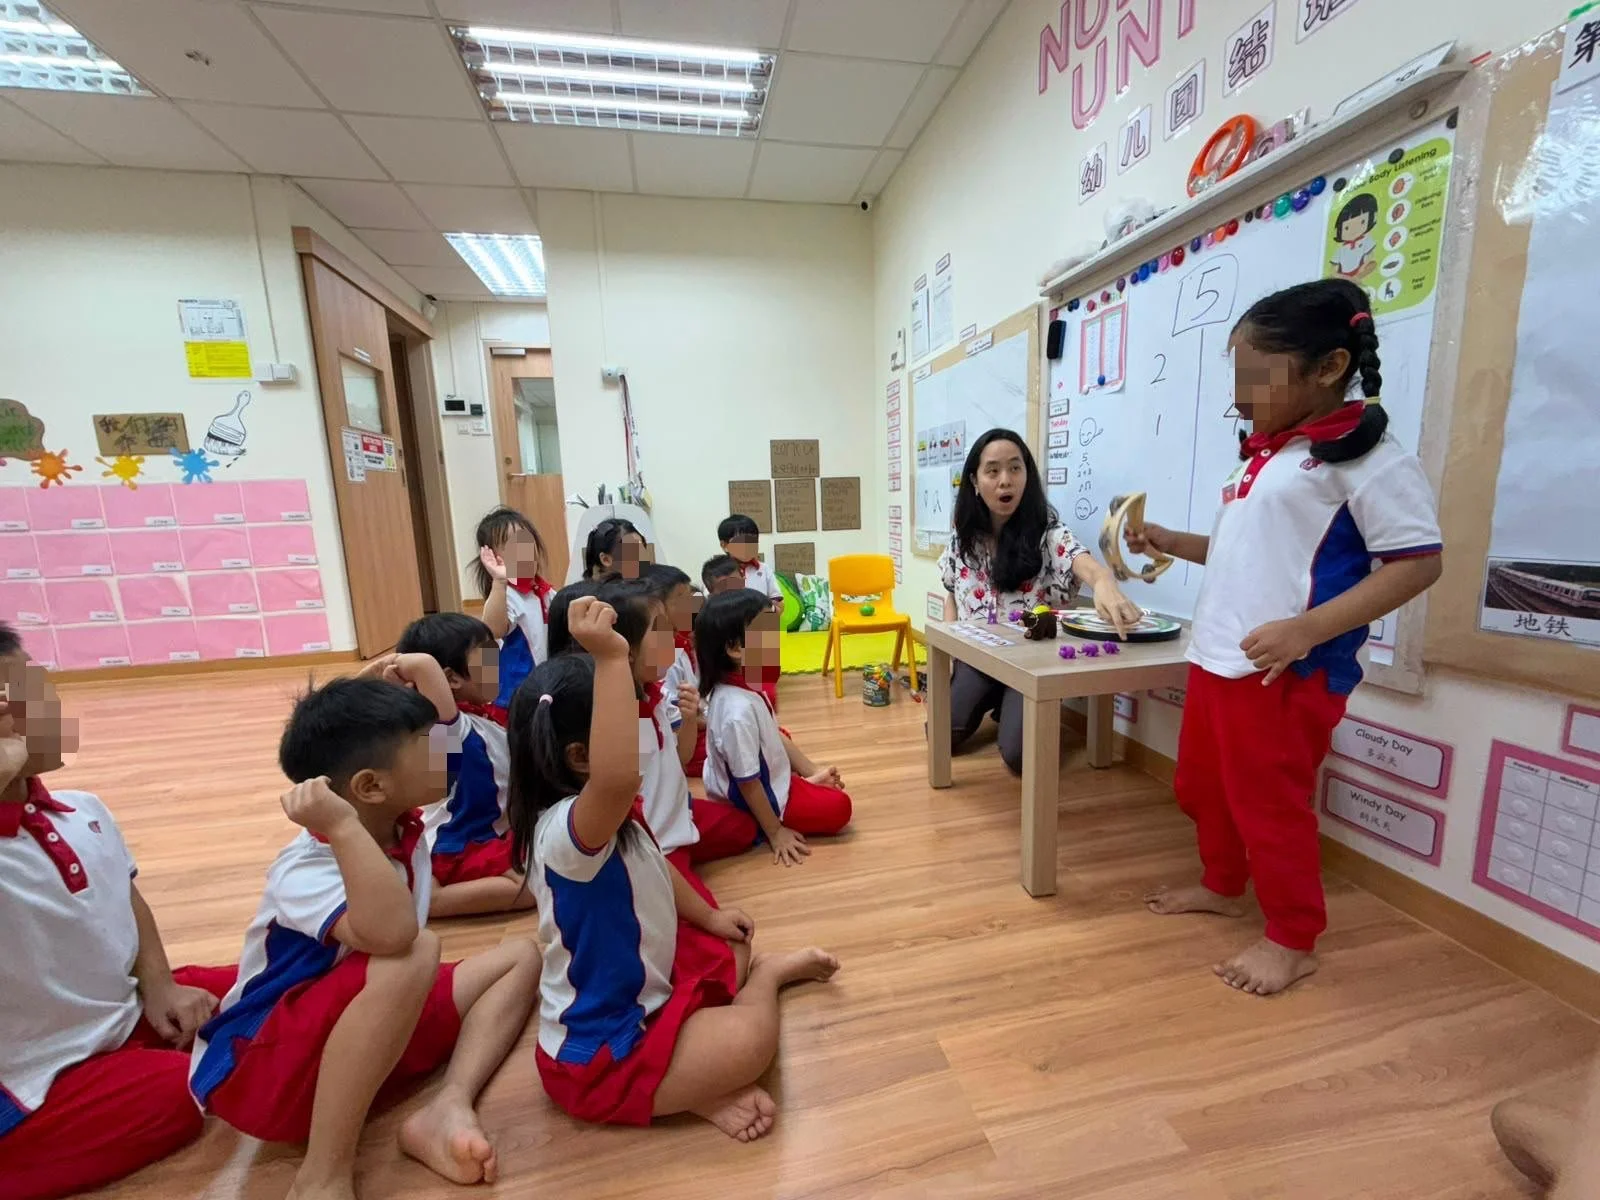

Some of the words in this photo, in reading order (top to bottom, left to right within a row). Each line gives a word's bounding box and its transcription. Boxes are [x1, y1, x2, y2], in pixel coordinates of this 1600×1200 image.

[1368, 168, 1392, 184] Body
[1393, 147, 1437, 172] Listening
[1191, 266, 1221, 321] 5
[1150, 353, 1167, 385] 2
[1155, 414, 1162, 436] 1
[1513, 613, 1573, 638] 地铁
[1355, 728, 1389, 748] Cloudy
[1391, 739, 1414, 756] Day
[1350, 790, 1382, 812] Windy
[1384, 804, 1407, 822] Day
